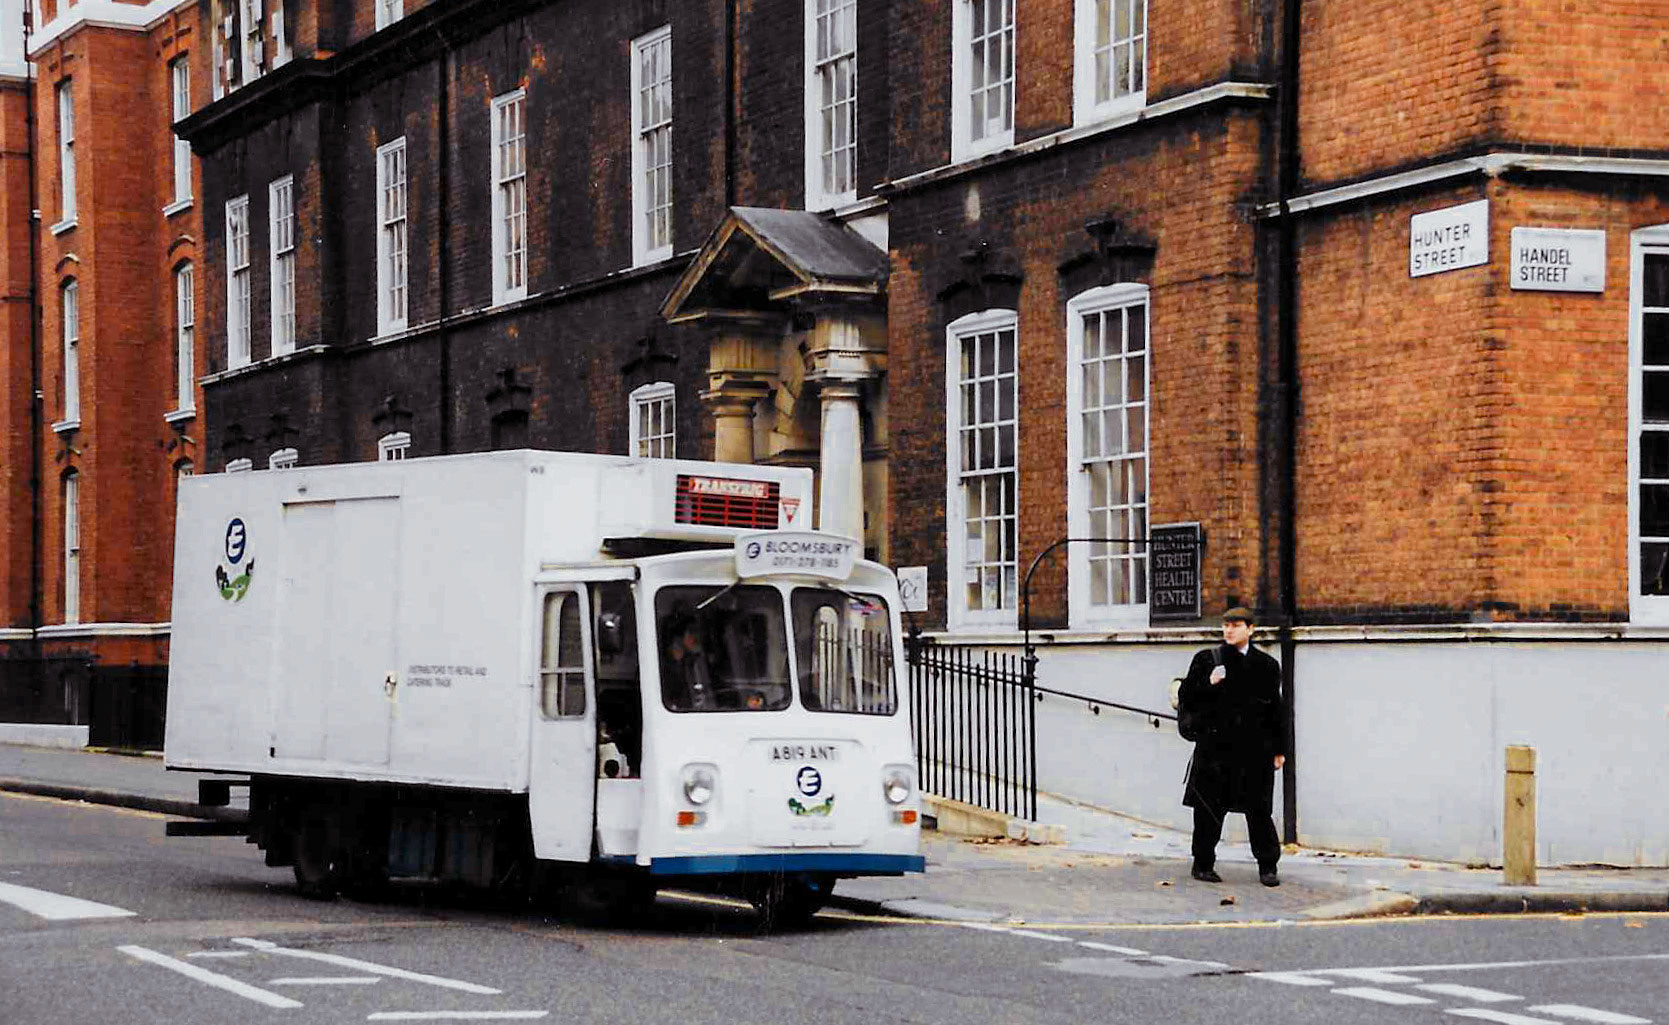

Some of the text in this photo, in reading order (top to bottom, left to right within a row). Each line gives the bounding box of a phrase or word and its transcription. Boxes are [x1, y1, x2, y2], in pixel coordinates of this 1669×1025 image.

[1414, 223, 1470, 246] HUNTER
[1414, 246, 1465, 269] STREET
[1519, 248, 1571, 265] HANDEL
[1519, 266, 1568, 282] STREET
[765, 540, 851, 555] BLOOMSBURY
[1153, 534, 1195, 550] HUNTER
[1156, 553, 1192, 568] STREET
[1154, 571, 1194, 587] HEALTH
[1154, 589, 1195, 606] CENTRE
[772, 745, 836, 760] A819 ANT
